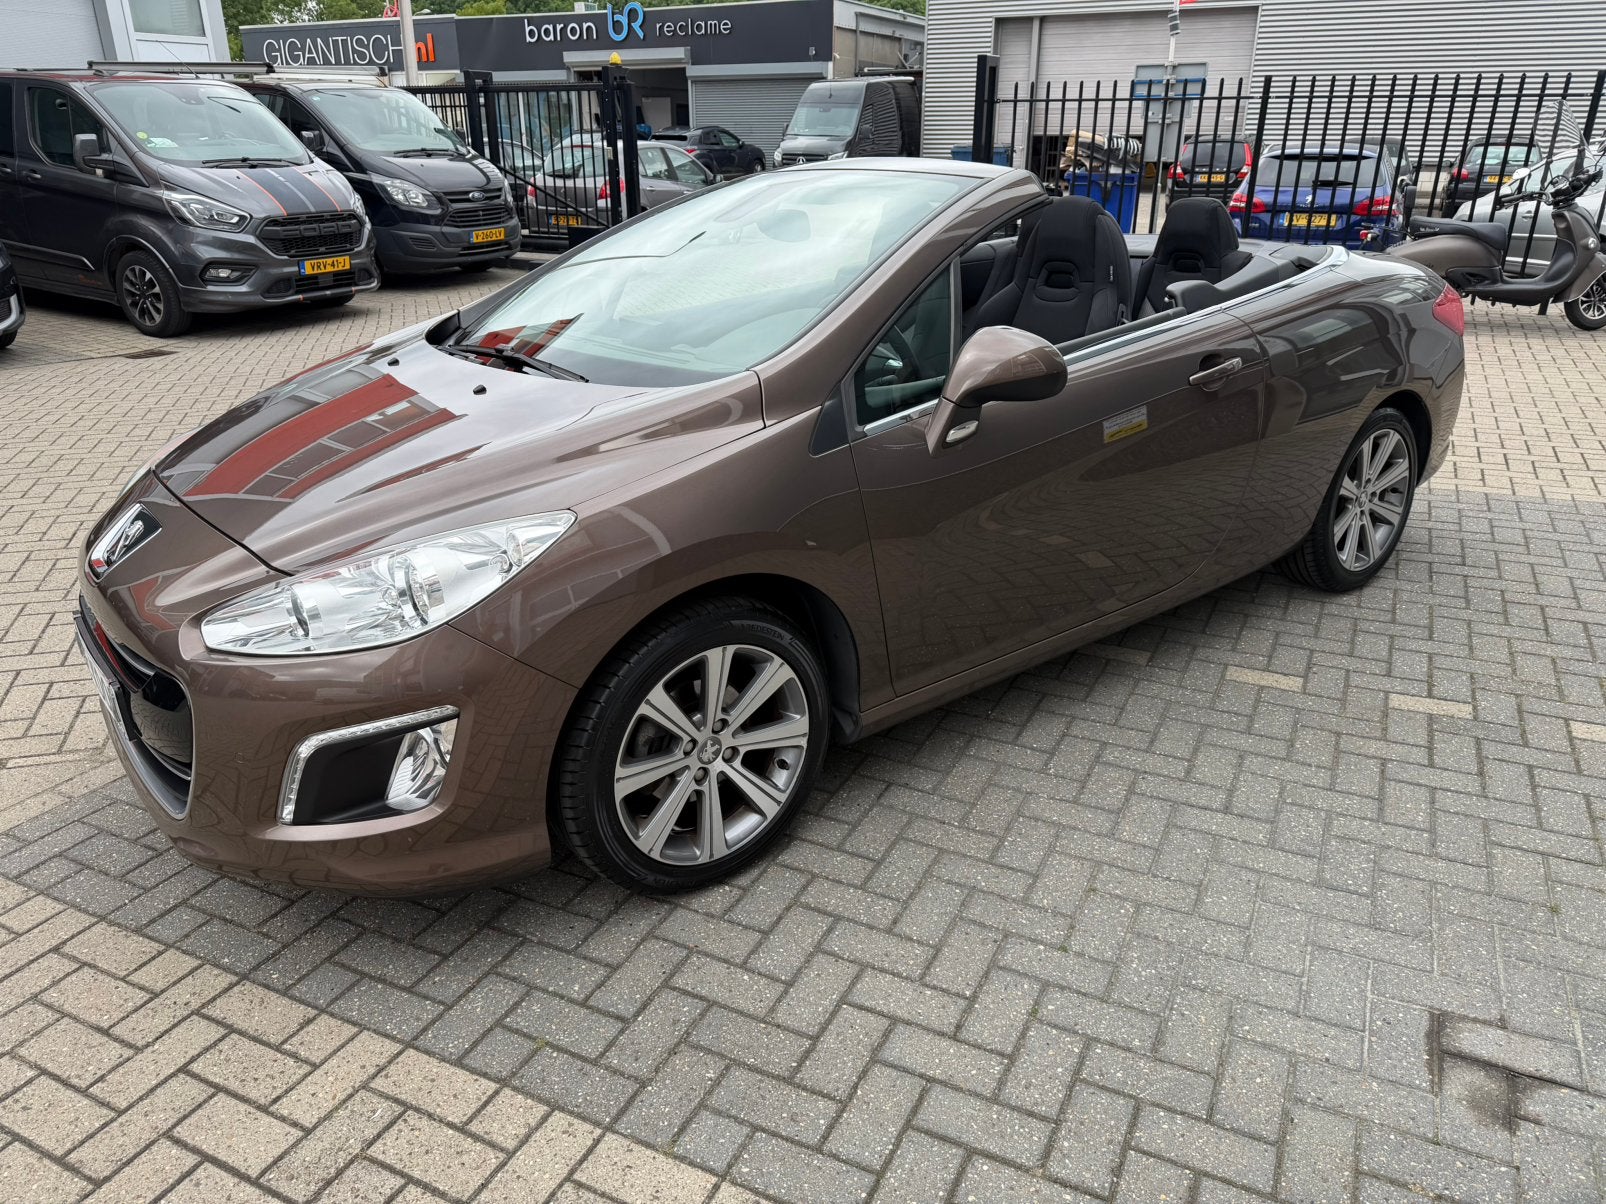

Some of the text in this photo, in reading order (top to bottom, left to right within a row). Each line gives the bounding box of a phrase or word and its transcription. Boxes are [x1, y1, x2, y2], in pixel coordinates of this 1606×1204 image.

[524, 18, 598, 43] baron
[655, 17, 733, 37] reclame
[474, 229, 503, 242] V-260-LV
[309, 259, 347, 273] VRV-41-J
